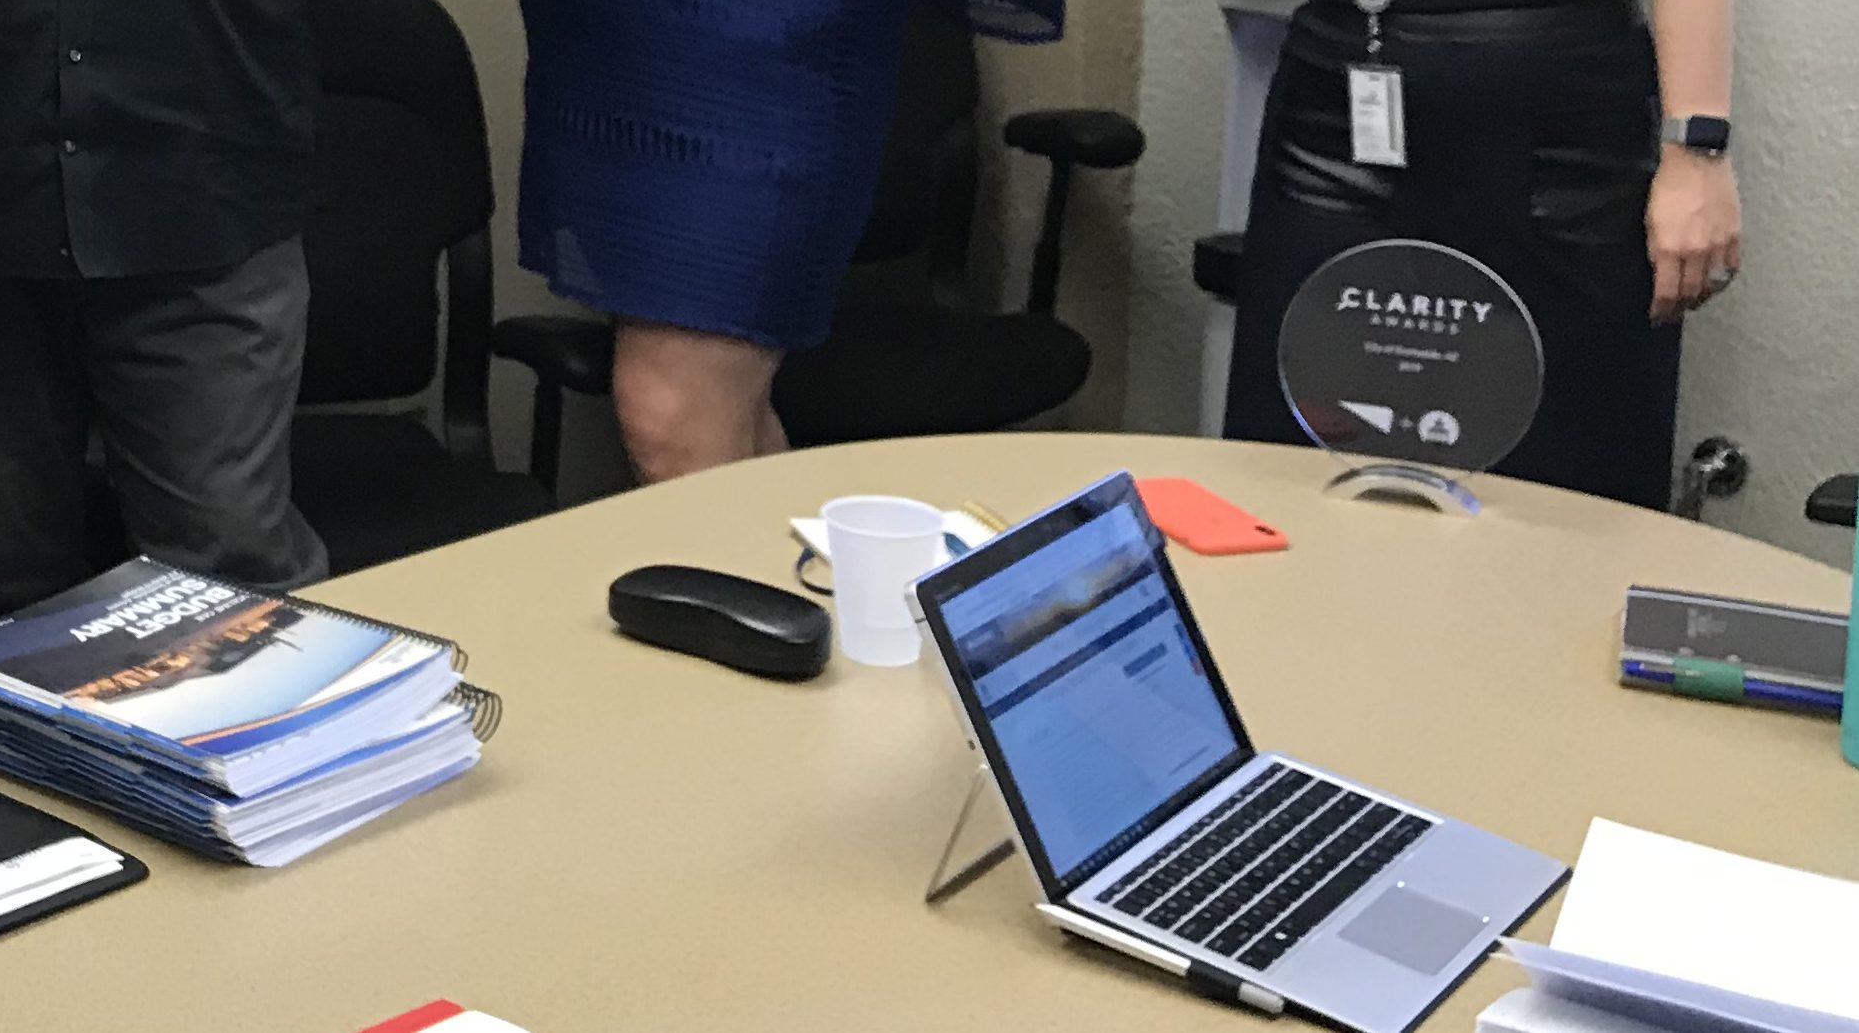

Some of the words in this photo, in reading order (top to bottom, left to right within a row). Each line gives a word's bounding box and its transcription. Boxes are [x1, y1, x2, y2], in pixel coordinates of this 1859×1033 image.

[1335, 286, 1493, 323] CLARITY
[69, 578, 208, 643] SUMMARY
[123, 585, 236, 640] BUDGET
